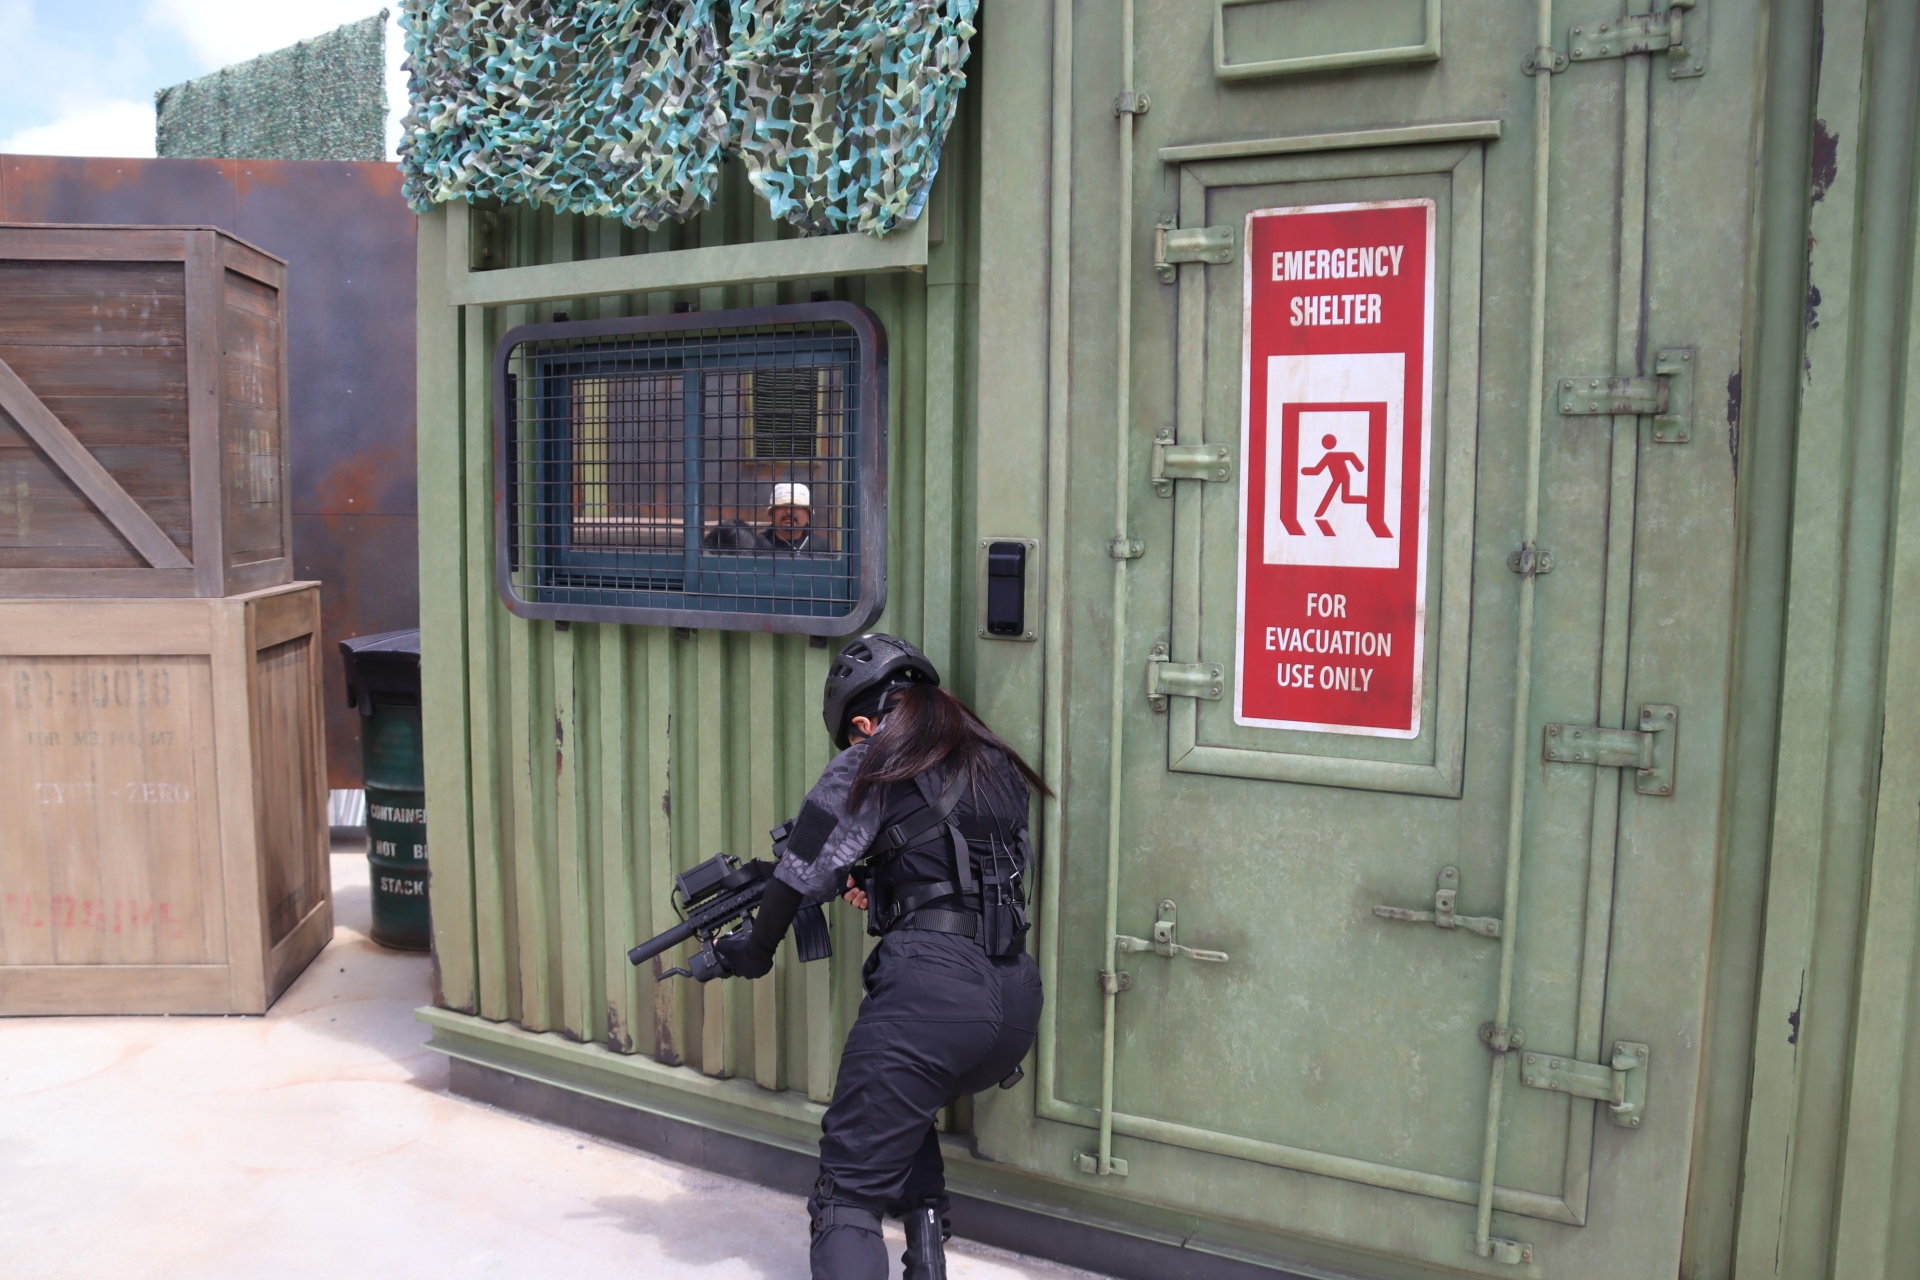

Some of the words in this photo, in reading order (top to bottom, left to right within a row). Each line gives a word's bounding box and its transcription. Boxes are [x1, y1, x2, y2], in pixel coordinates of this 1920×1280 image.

[1271, 245, 1404, 282] EMERGENCY
[1289, 293, 1382, 327] SHELTER
[1306, 592, 1347, 619] FOR
[1265, 626, 1392, 658] EVACUATION
[1277, 662, 1315, 689] USE
[1319, 665, 1374, 693] ONLY
[28, 730, 61, 747] FOR
[126, 782, 190, 804] ZERO
[376, 840, 397, 857] NOT
[380, 876, 425, 896] STACK
